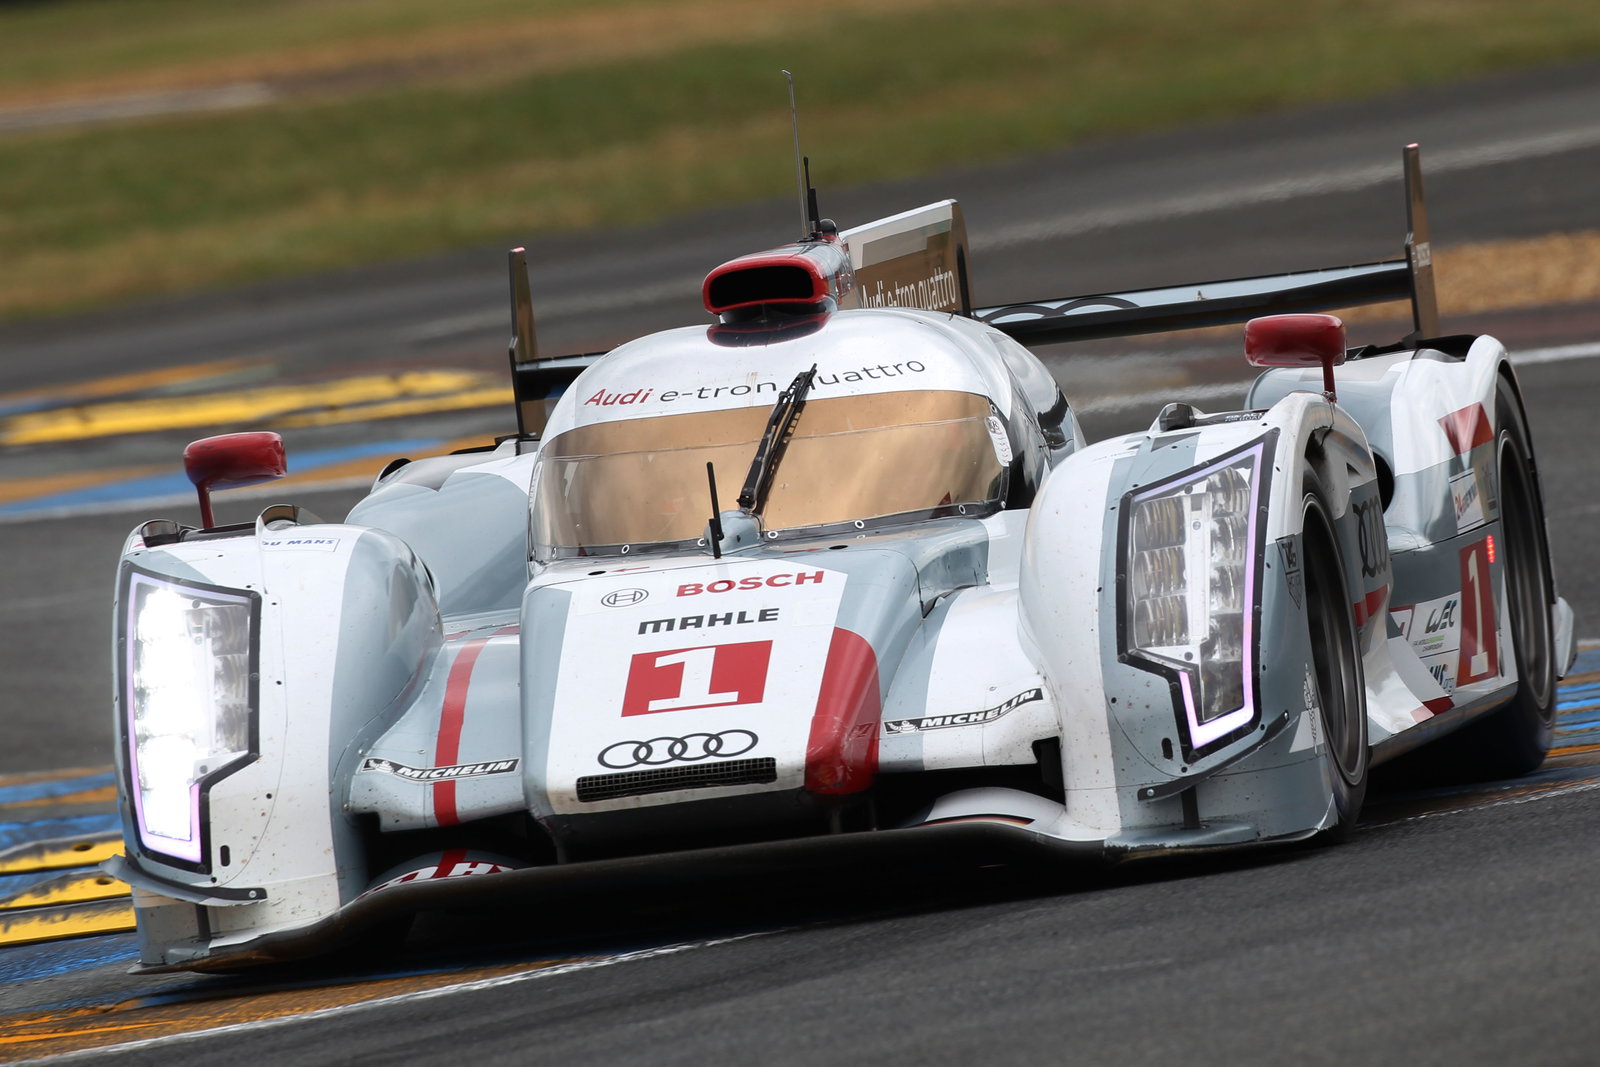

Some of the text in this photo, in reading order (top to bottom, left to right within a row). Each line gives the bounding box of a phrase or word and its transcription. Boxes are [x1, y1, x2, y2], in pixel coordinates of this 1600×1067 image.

[862, 266, 956, 311] Audi e-tron quattro
[584, 360, 926, 406] Audi e-tron uattro
[675, 570, 825, 597] BOSCH
[637, 607, 780, 635] MAHLE
[1425, 599, 1458, 634] WEC
[1467, 549, 1489, 677] 1
[647, 647, 740, 712] 1
[919, 689, 1037, 728] MICHELIN
[396, 760, 515, 779] MICHELIN
